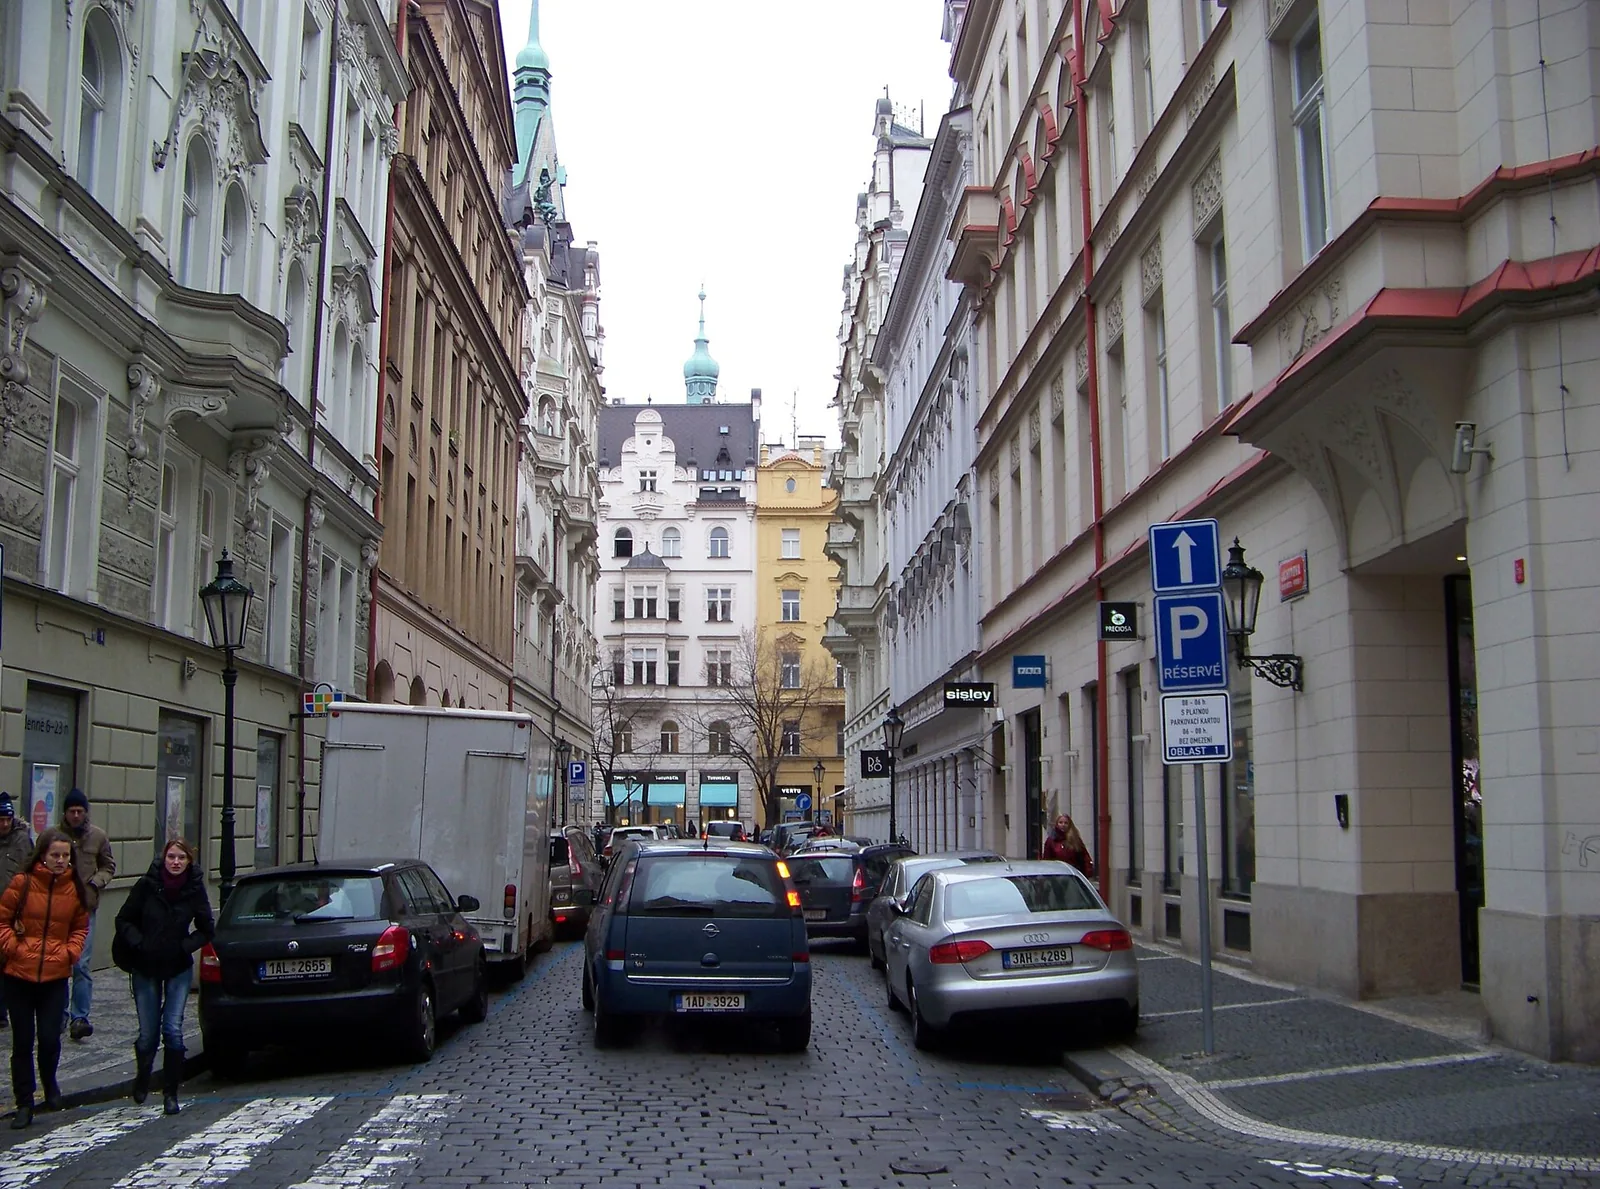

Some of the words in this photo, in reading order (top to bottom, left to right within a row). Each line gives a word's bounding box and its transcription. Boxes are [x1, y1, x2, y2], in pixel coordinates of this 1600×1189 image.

[1170, 606, 1208, 660] P
[1164, 662, 1221, 679] RÉSERVÉ
[946, 689, 991, 701] sisley
[1170, 717, 1199, 726] PARKOVACÍ
[1190, 736, 1212, 744] OMEZENÍ
[1170, 746, 1206, 756] OBLAST
[1214, 746, 1218, 754] 1
[572, 764, 582, 778] P
[1012, 952, 1032, 964] 3AH
[1040, 950, 1066, 962] 4289
[270, 962, 289, 974] 1AL
[298, 960, 326, 972] 2655
[686, 996, 704, 1008] 1AD
[714, 996, 740, 1008] 3929
